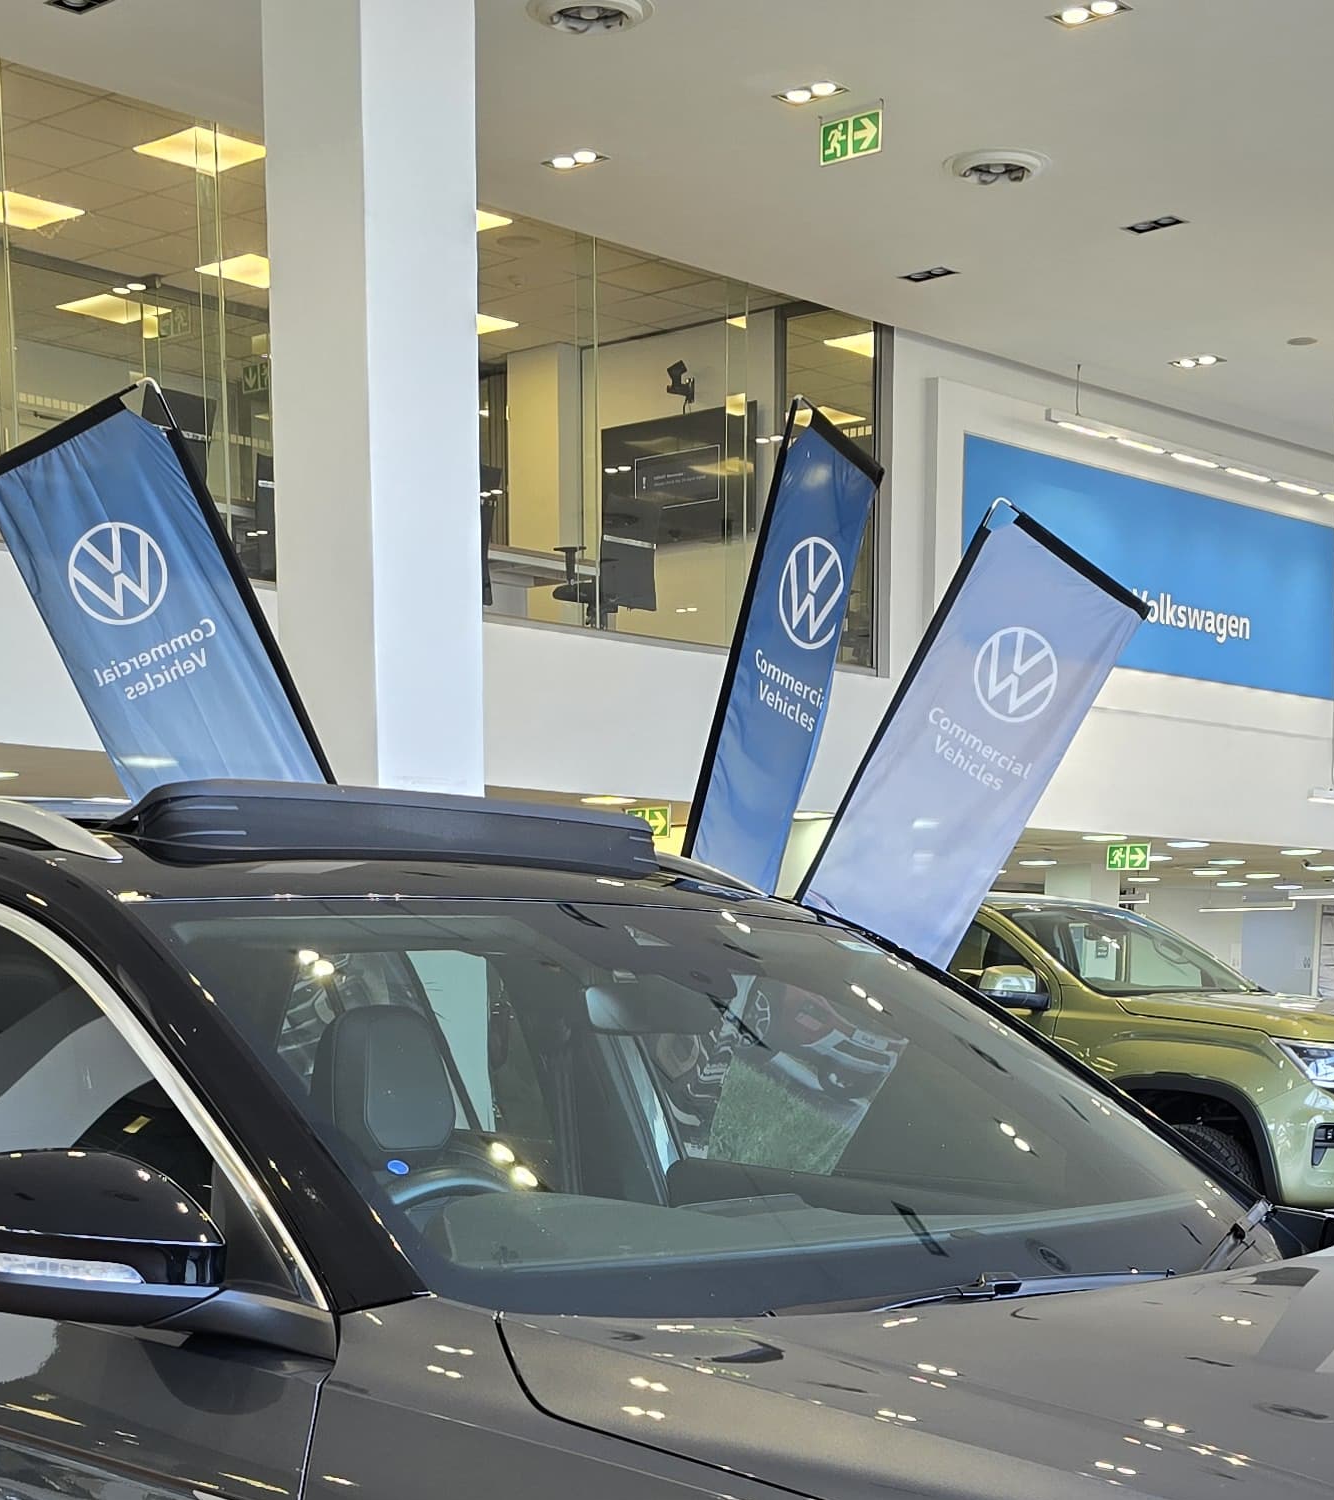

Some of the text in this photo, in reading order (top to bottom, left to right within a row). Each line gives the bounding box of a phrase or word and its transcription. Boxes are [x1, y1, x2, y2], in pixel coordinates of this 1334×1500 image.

[754, 649, 826, 710] Commercia
[759, 680, 816, 732] Vehicles
[928, 706, 1033, 780] Commercial
[935, 735, 1004, 791] Vehicles
